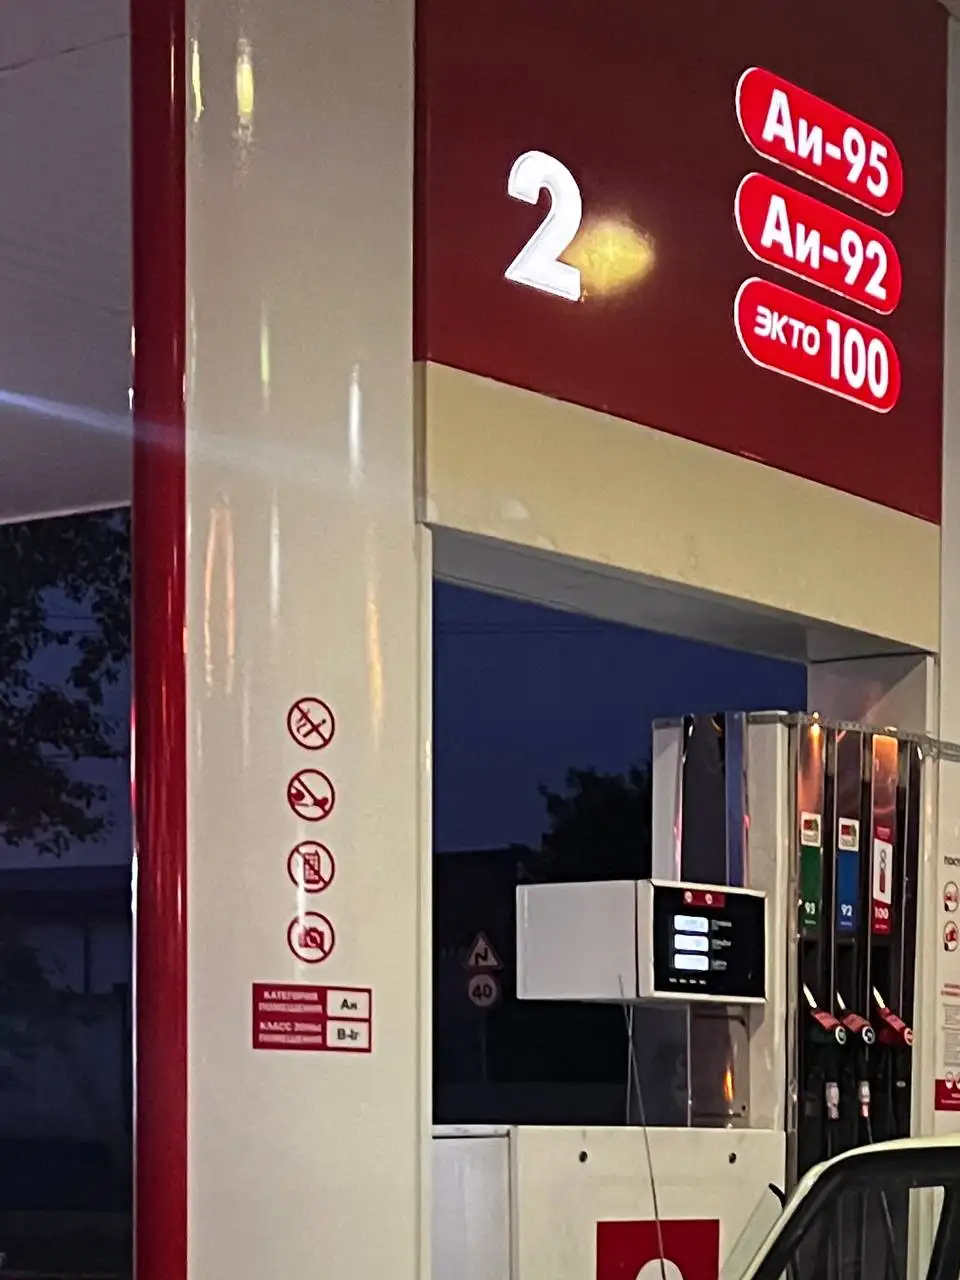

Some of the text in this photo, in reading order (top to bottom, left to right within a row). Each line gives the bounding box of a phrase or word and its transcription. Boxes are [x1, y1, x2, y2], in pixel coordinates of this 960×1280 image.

[761, 88, 890, 198] Аи-95
[504, 150, 583, 302] 2
[760, 194, 888, 300] Аи-92
[826, 320, 889, 399] 100
[841, 904, 853, 917] 92
[874, 907, 889, 920] 100
[472, 983, 493, 1000] 40
